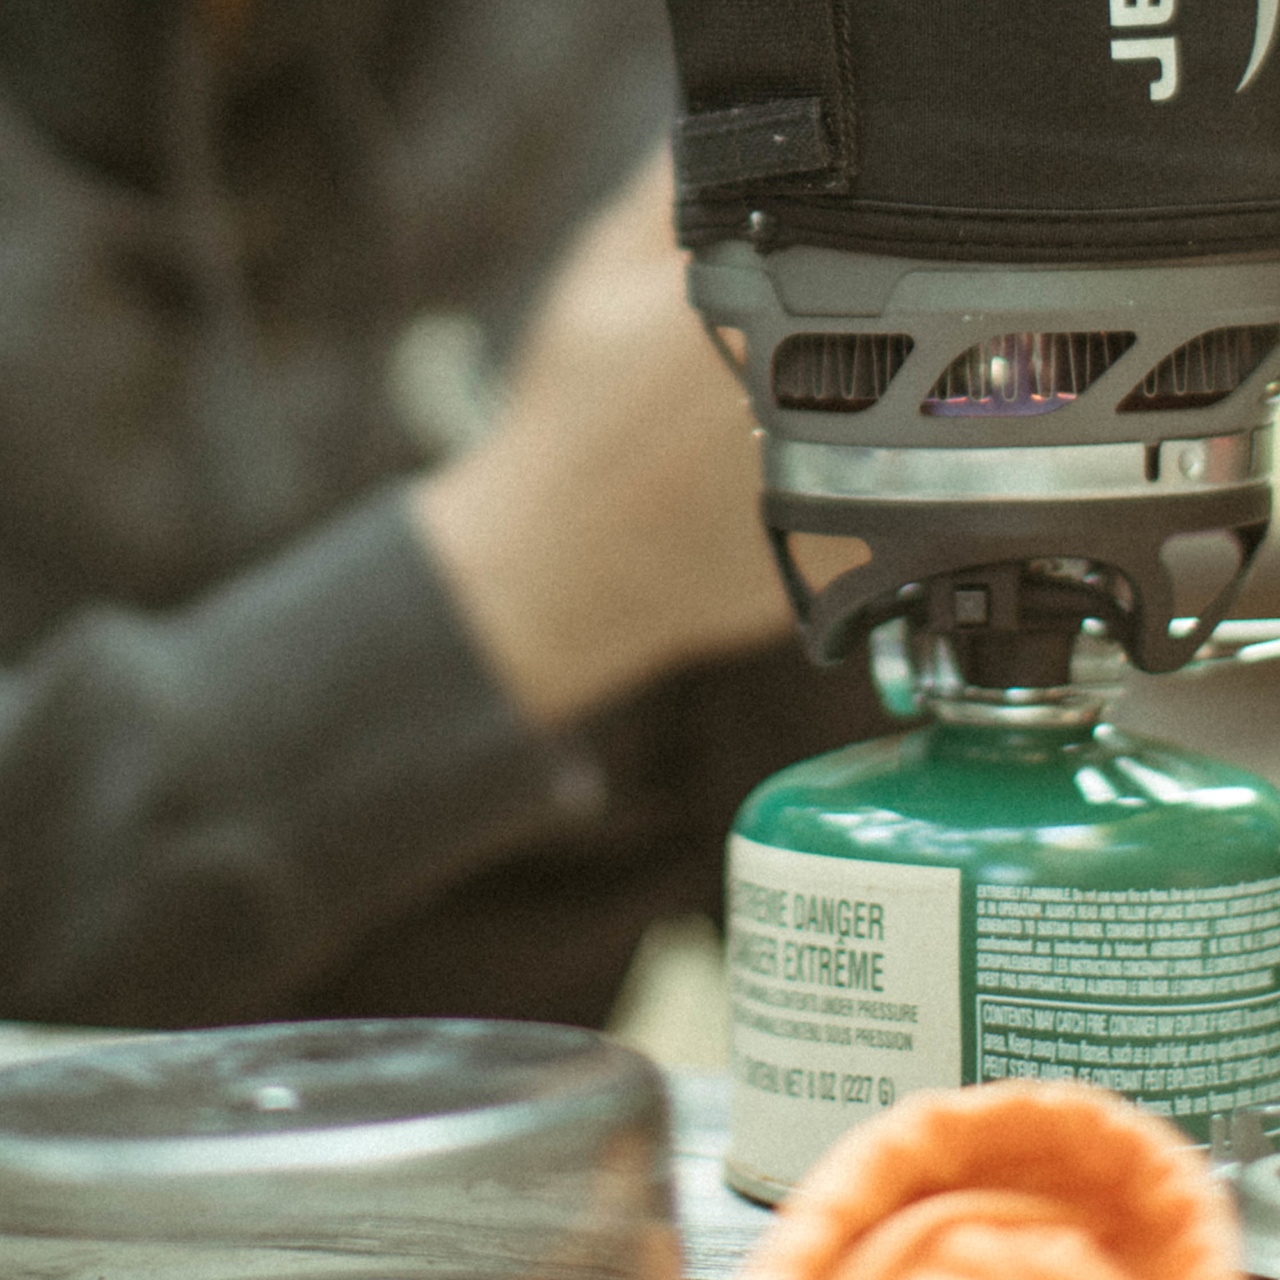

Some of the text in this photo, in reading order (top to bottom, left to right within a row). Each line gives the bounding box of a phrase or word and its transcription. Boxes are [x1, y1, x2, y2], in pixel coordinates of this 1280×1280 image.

[794, 894, 885, 941] DANGER
[784, 936, 885, 992] EXTRÊME
[857, 999, 920, 1024] PRESSURE
[983, 1003, 1033, 1028] CONTENTS
[1034, 1008, 1055, 1031] MAY
[1056, 1011, 1086, 1033] CATCH
[856, 1026, 914, 1051] PRESSION
[1008, 1031, 1032, 1059] Keep
[984, 1054, 1008, 1078] PEUT
[841, 1073, 872, 1109] (227
[878, 1076, 896, 1106] G)
